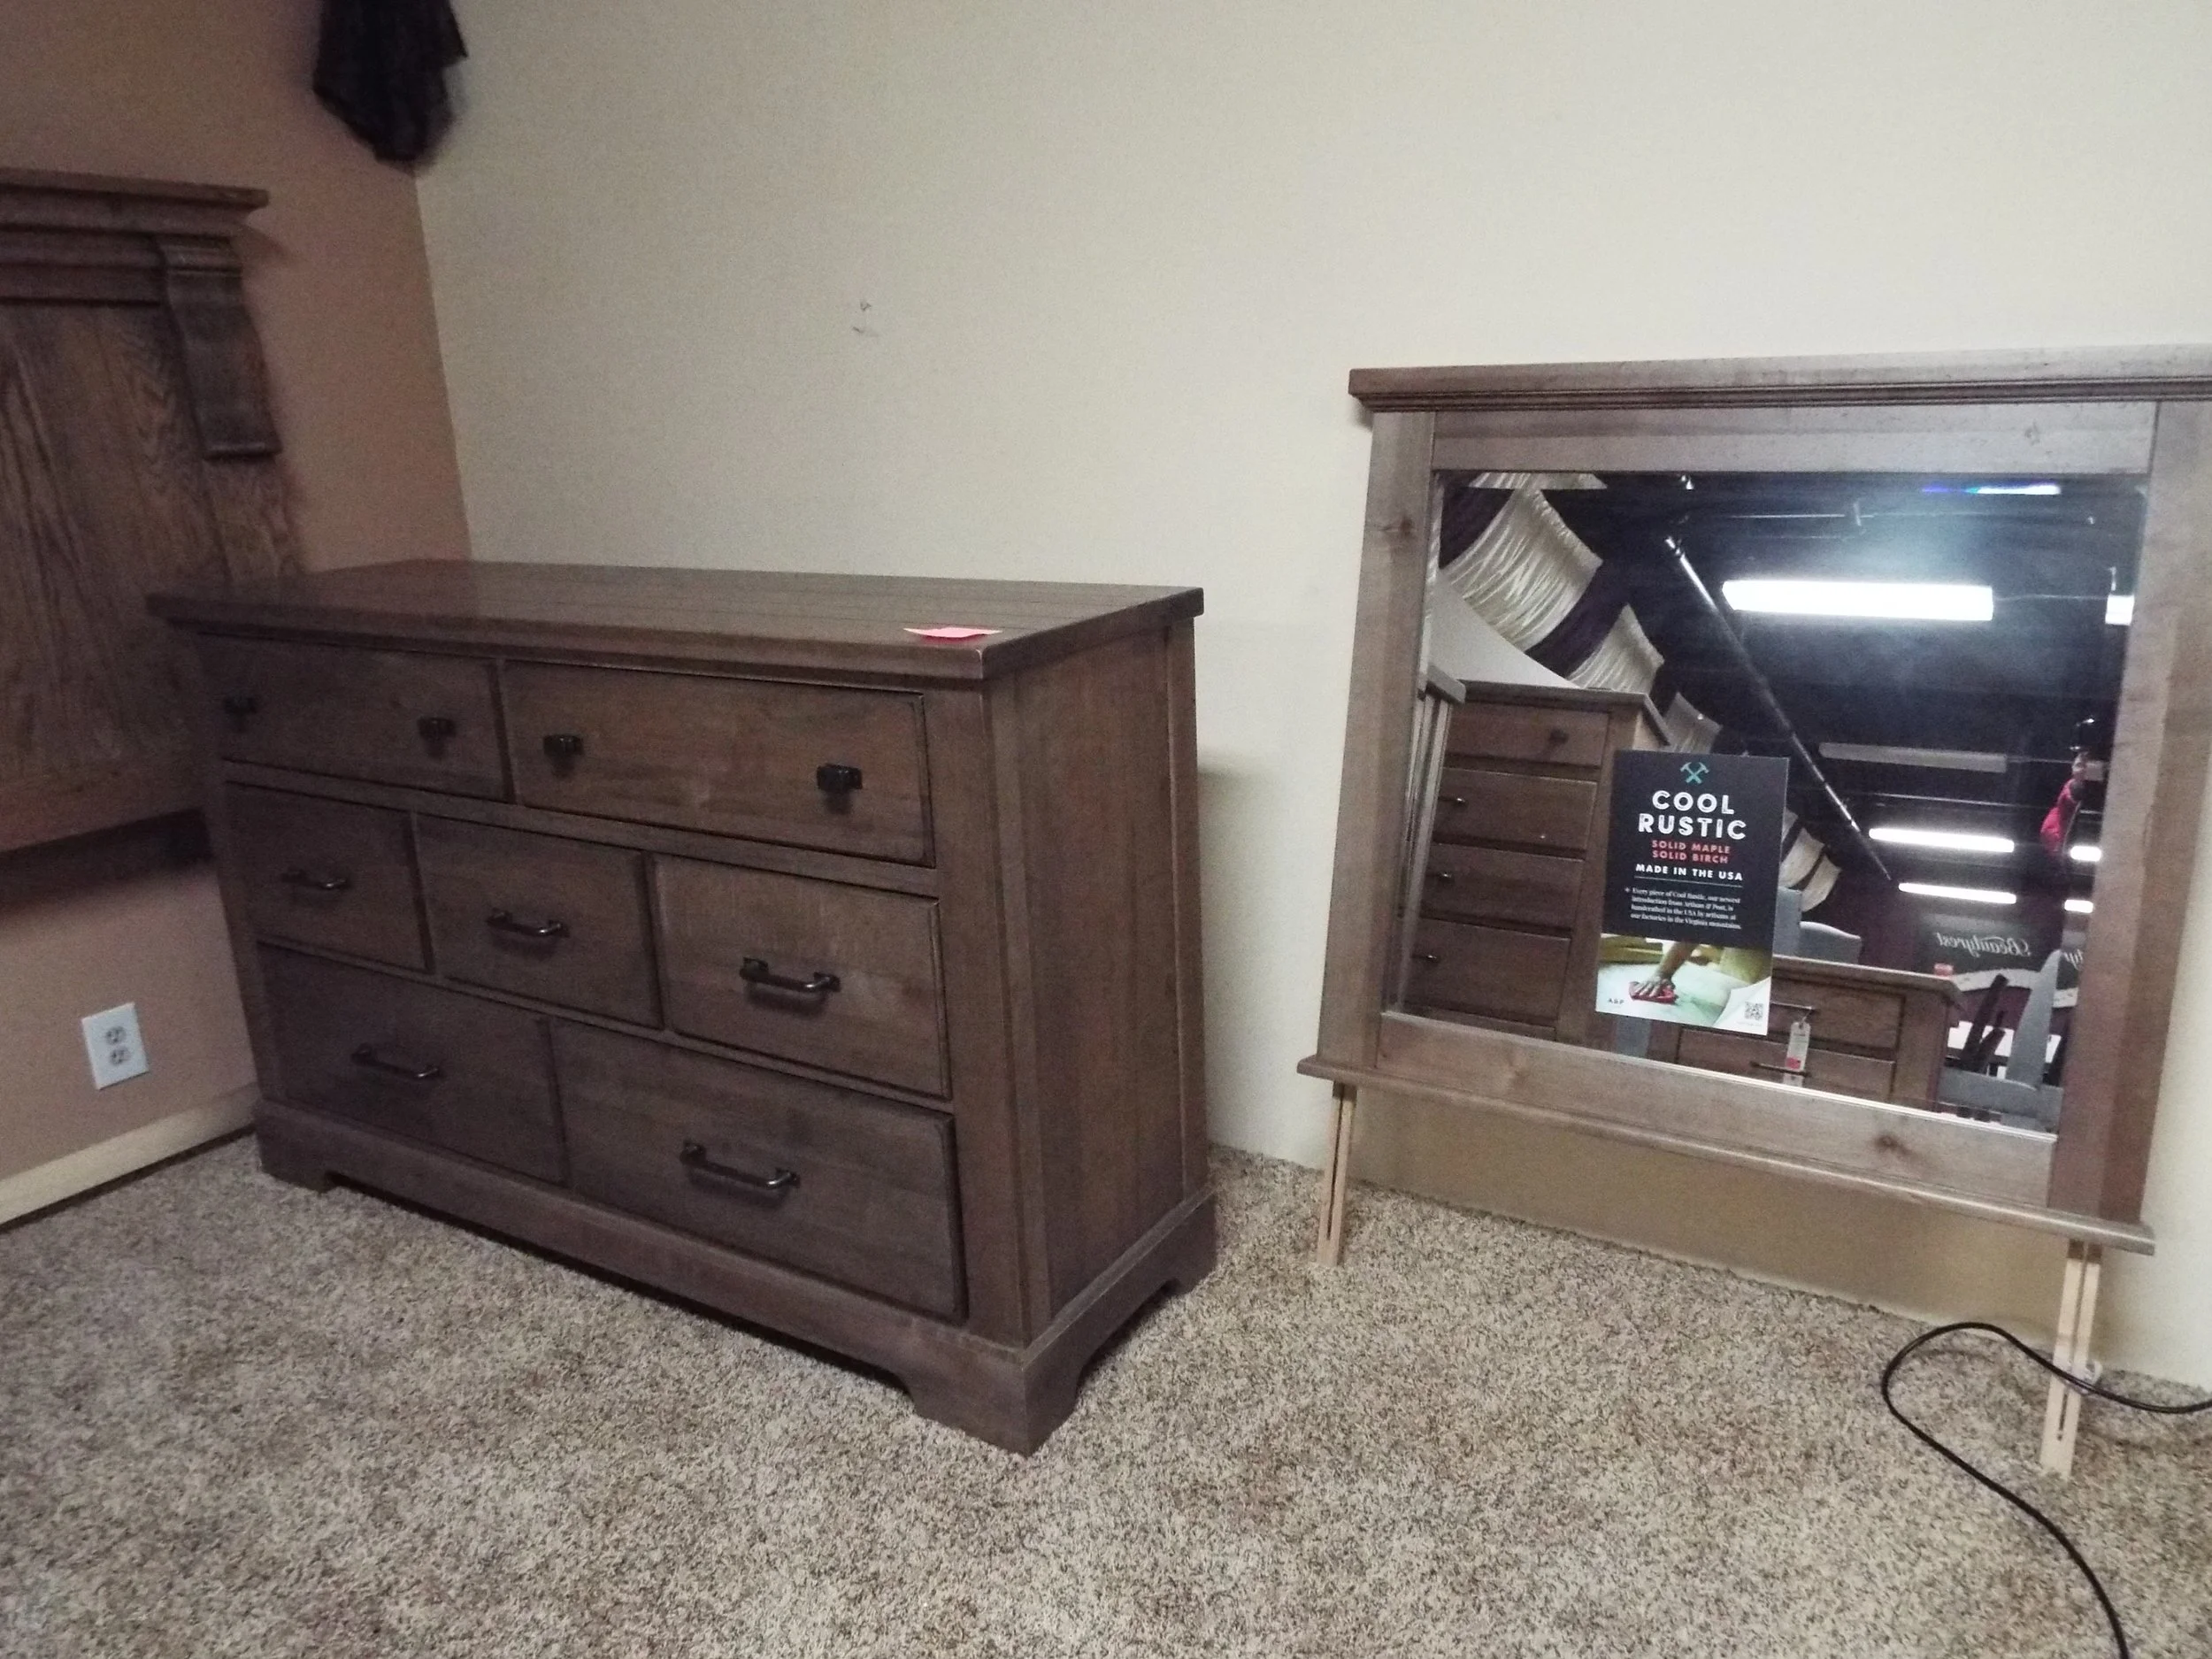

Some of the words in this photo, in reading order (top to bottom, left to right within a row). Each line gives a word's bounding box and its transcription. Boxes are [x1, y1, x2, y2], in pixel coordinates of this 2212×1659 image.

[1652, 790, 1734, 815] COOL
[1638, 813, 1747, 840] RUSTIC
[1651, 840, 1686, 849] SOLID
[1691, 842, 1731, 854] MAPLE
[1652, 849, 1687, 861] SOLID
[1692, 853, 1728, 864] BIRCH
[1635, 864, 1669, 874] MADE
[1673, 867, 1687, 876] IN
[1693, 868, 1714, 879] THE
[1718, 872, 1743, 881] USA
